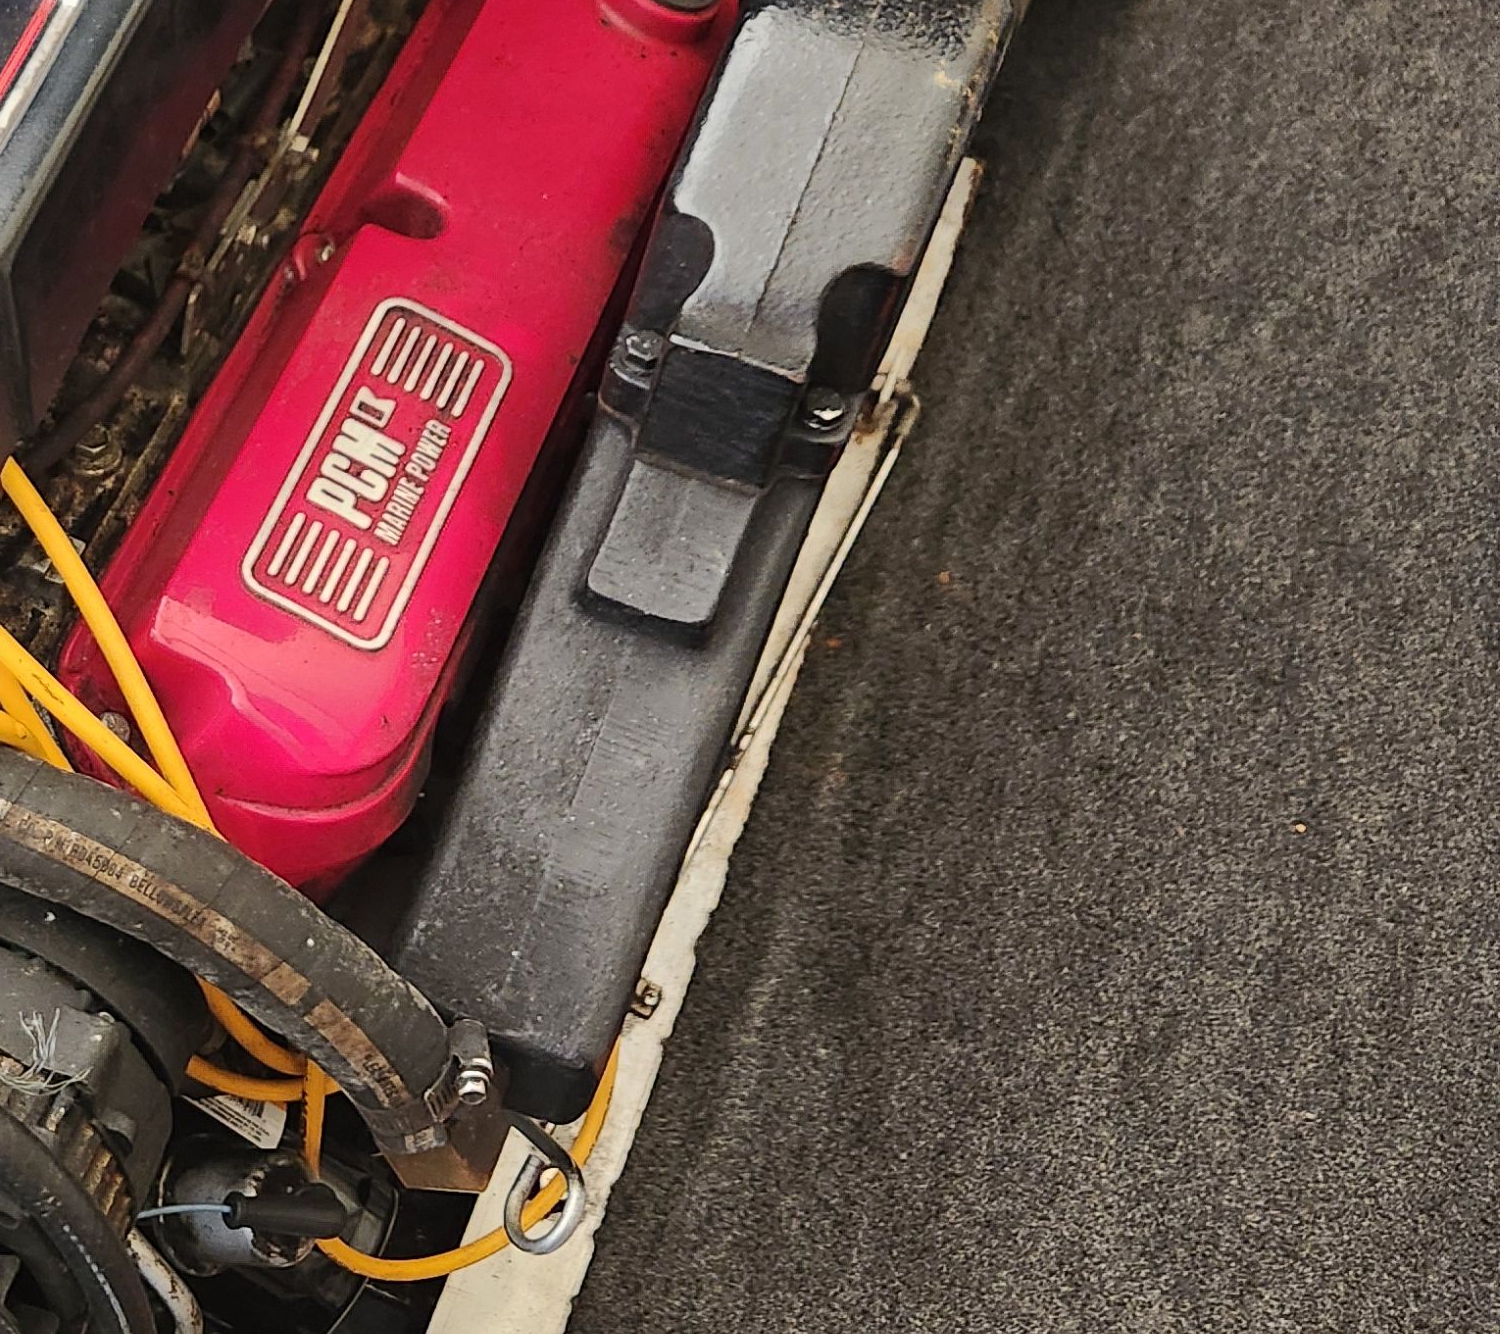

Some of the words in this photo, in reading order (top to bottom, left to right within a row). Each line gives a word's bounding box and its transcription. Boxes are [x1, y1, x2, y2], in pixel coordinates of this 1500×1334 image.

[306, 418, 406, 530] PCM
[373, 476, 425, 546] MARINE
[404, 419, 452, 482] POWER
